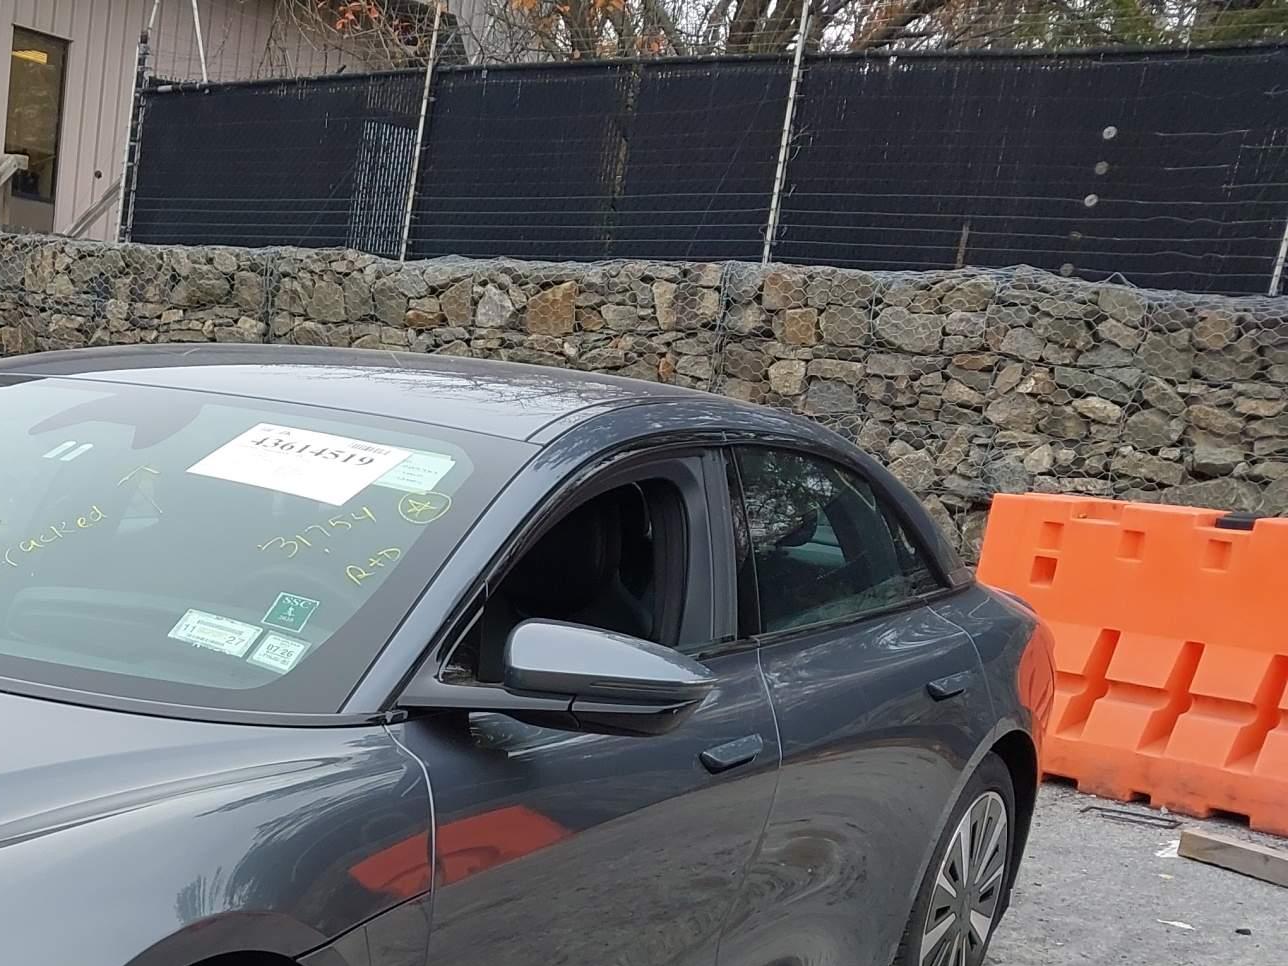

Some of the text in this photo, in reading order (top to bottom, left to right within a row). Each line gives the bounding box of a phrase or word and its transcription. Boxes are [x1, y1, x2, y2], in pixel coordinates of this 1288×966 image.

[251, 436, 374, 466] 43614519
[282, 596, 312, 609] SSC
[182, 623, 197, 634] 11
[225, 635, 246, 647] 27
[266, 643, 281, 655] 07
[280, 648, 294, 659] 26
